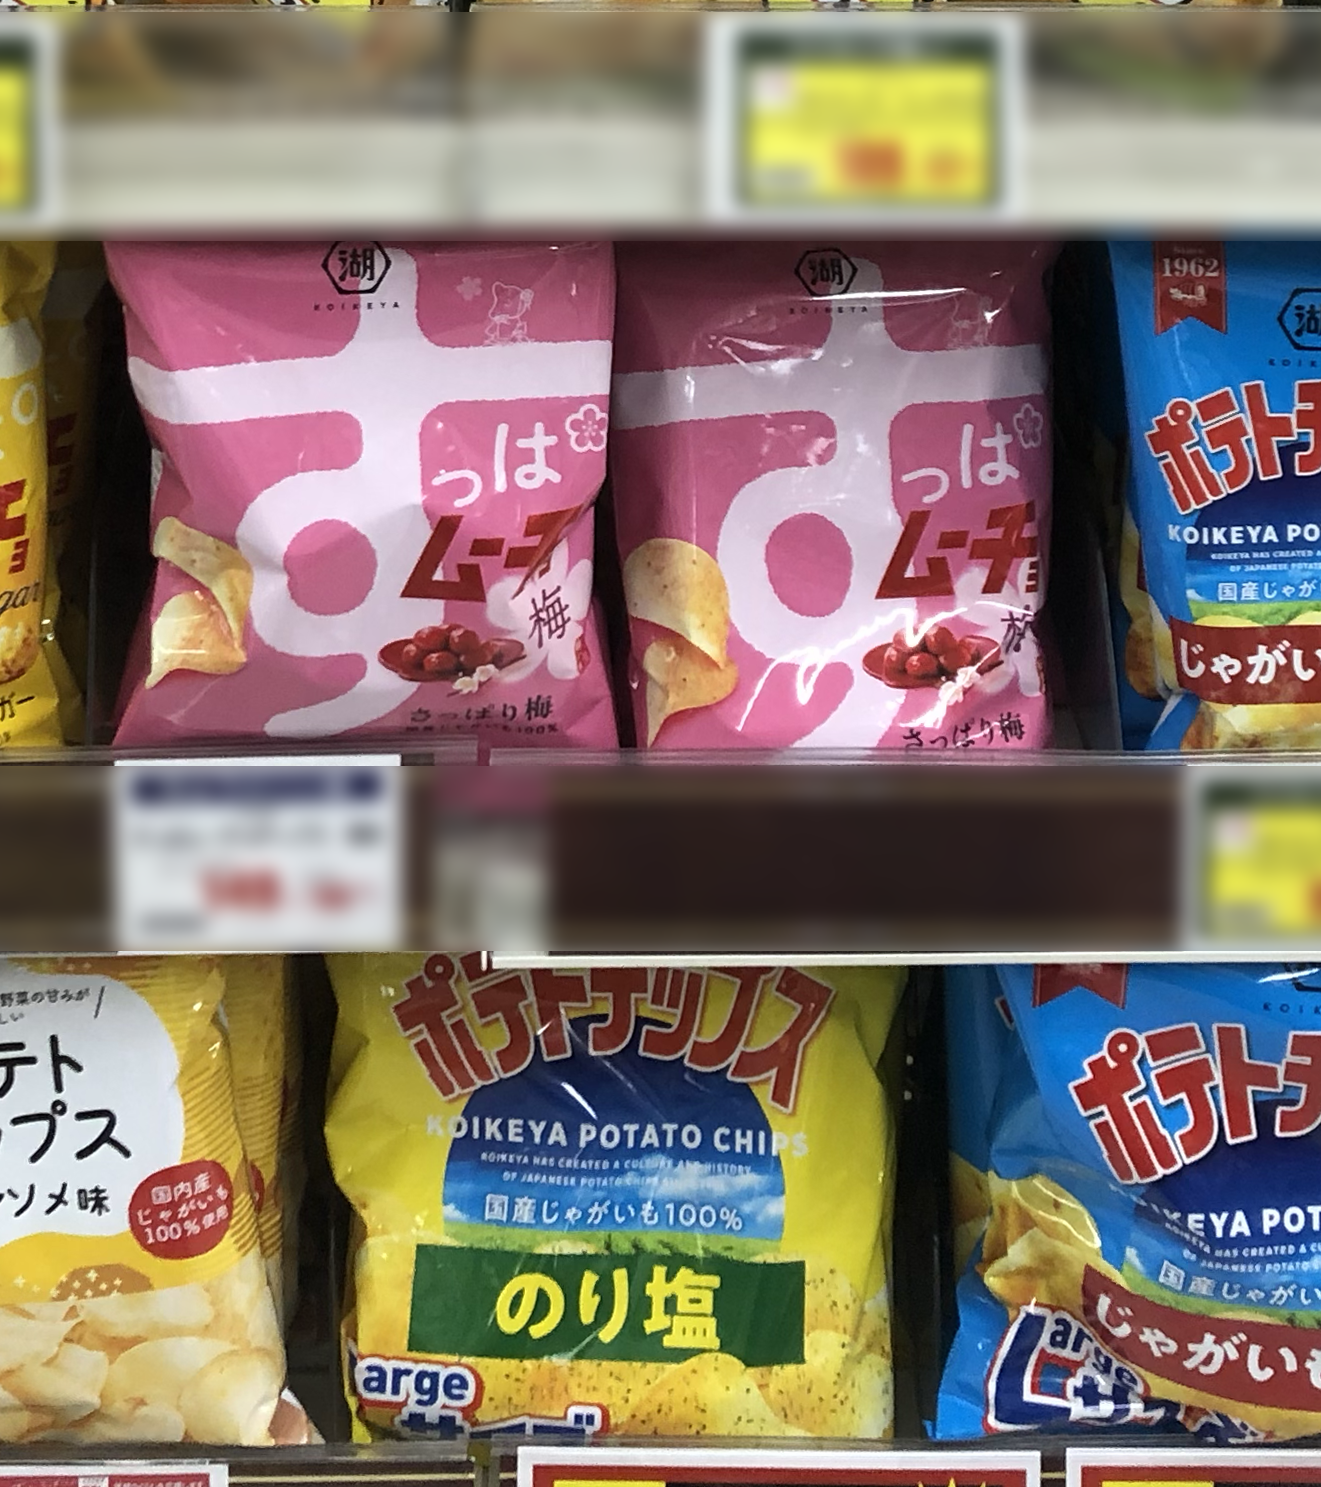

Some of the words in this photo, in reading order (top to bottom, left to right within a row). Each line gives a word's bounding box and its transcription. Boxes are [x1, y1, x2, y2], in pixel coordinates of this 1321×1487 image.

[1161, 258, 1220, 278] 1962
[1169, 523, 1278, 546] KOIKEYA
[530, 586, 571, 647] 梅
[410, 694, 553, 723] さっぱり梅
[426, 1115, 567, 1149] KOIKEYA
[579, 1122, 701, 1150] POTATO
[714, 1125, 809, 1157] CHIPS
[532, 1156, 554, 1167] HAS
[557, 1156, 610, 1169] CREATED
[613, 1159, 621, 1169] A
[152, 1173, 212, 1205] 国内産
[485, 1194, 744, 1231] 国産じゃがいも100%
[496, 1266, 721, 1350] のり塩
